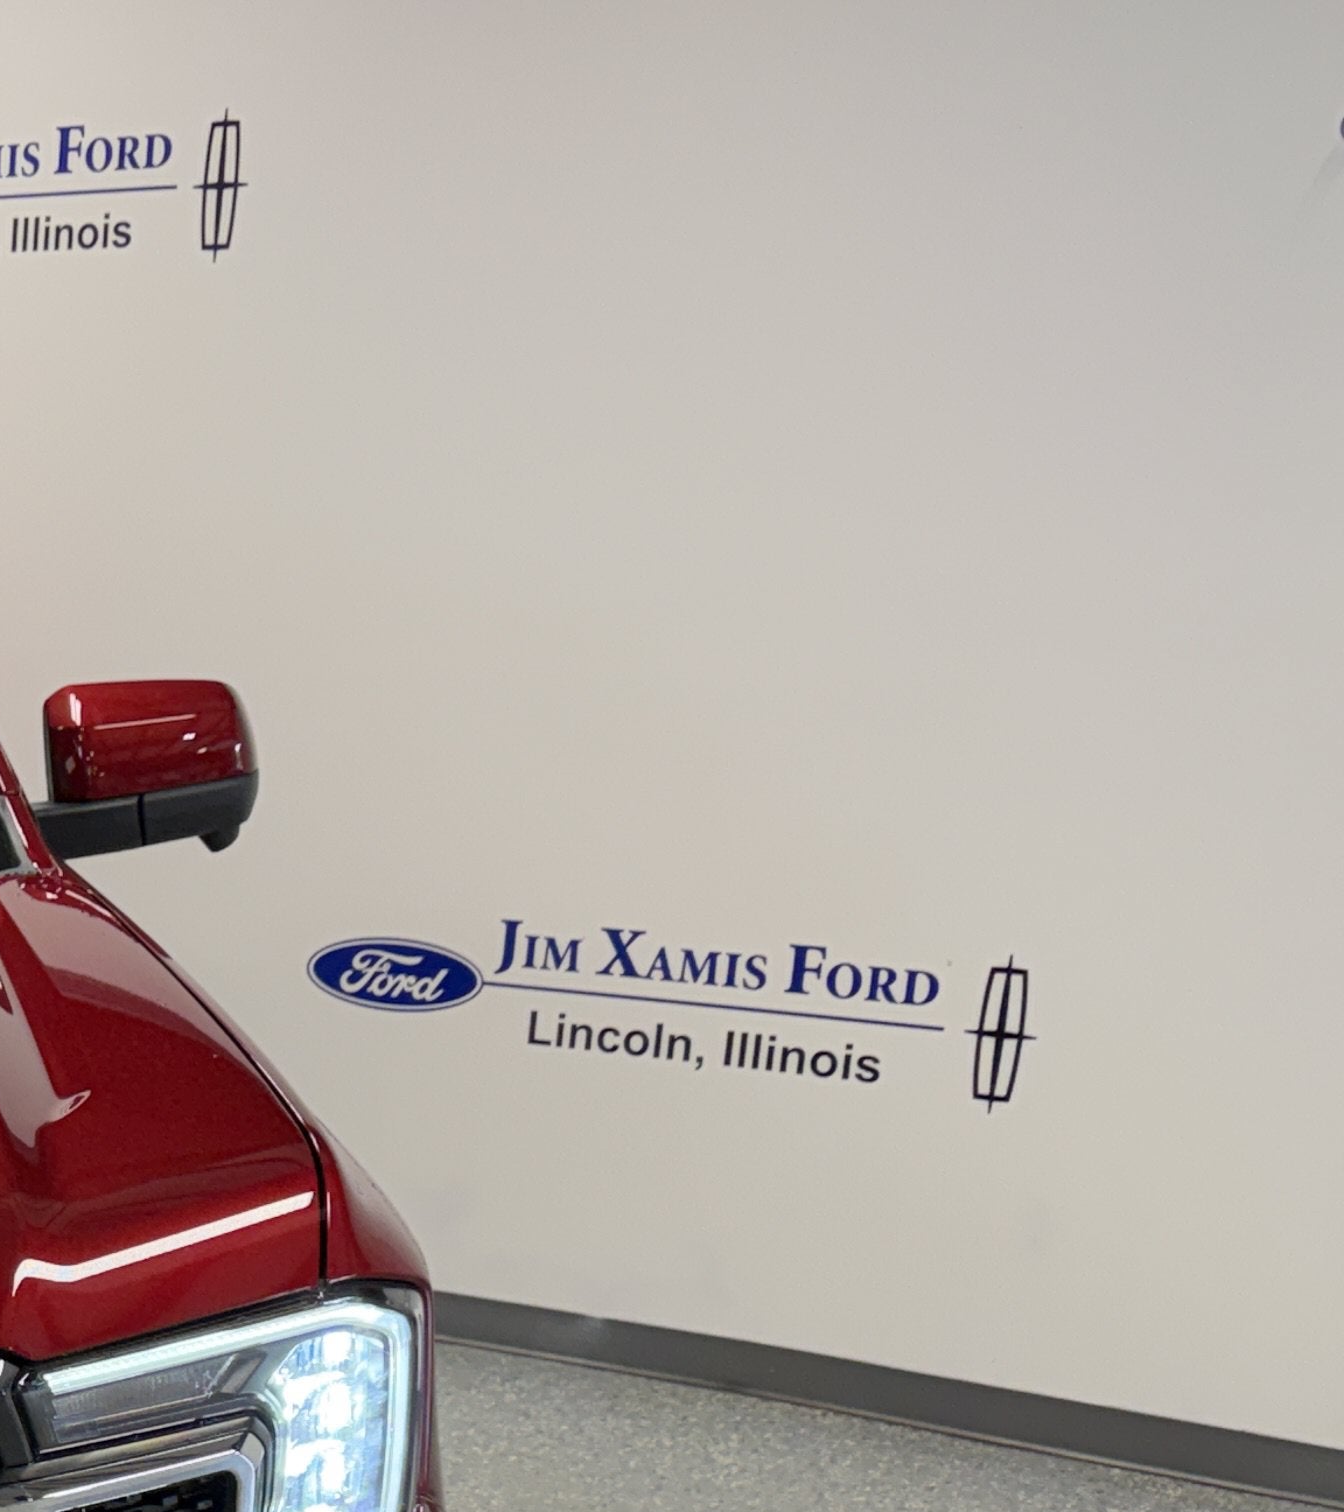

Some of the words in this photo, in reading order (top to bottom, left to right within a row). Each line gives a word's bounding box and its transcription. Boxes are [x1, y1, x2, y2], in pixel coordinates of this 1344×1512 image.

[55, 126, 171, 173] FORD
[12, 214, 131, 252] Illinois
[338, 949, 445, 1003] Ford
[495, 920, 580, 973] JIM
[597, 929, 766, 990] XAMIS
[785, 945, 938, 1005] FORD
[528, 1010, 704, 1069] Lincoln,
[724, 1032, 879, 1082] Illinois
